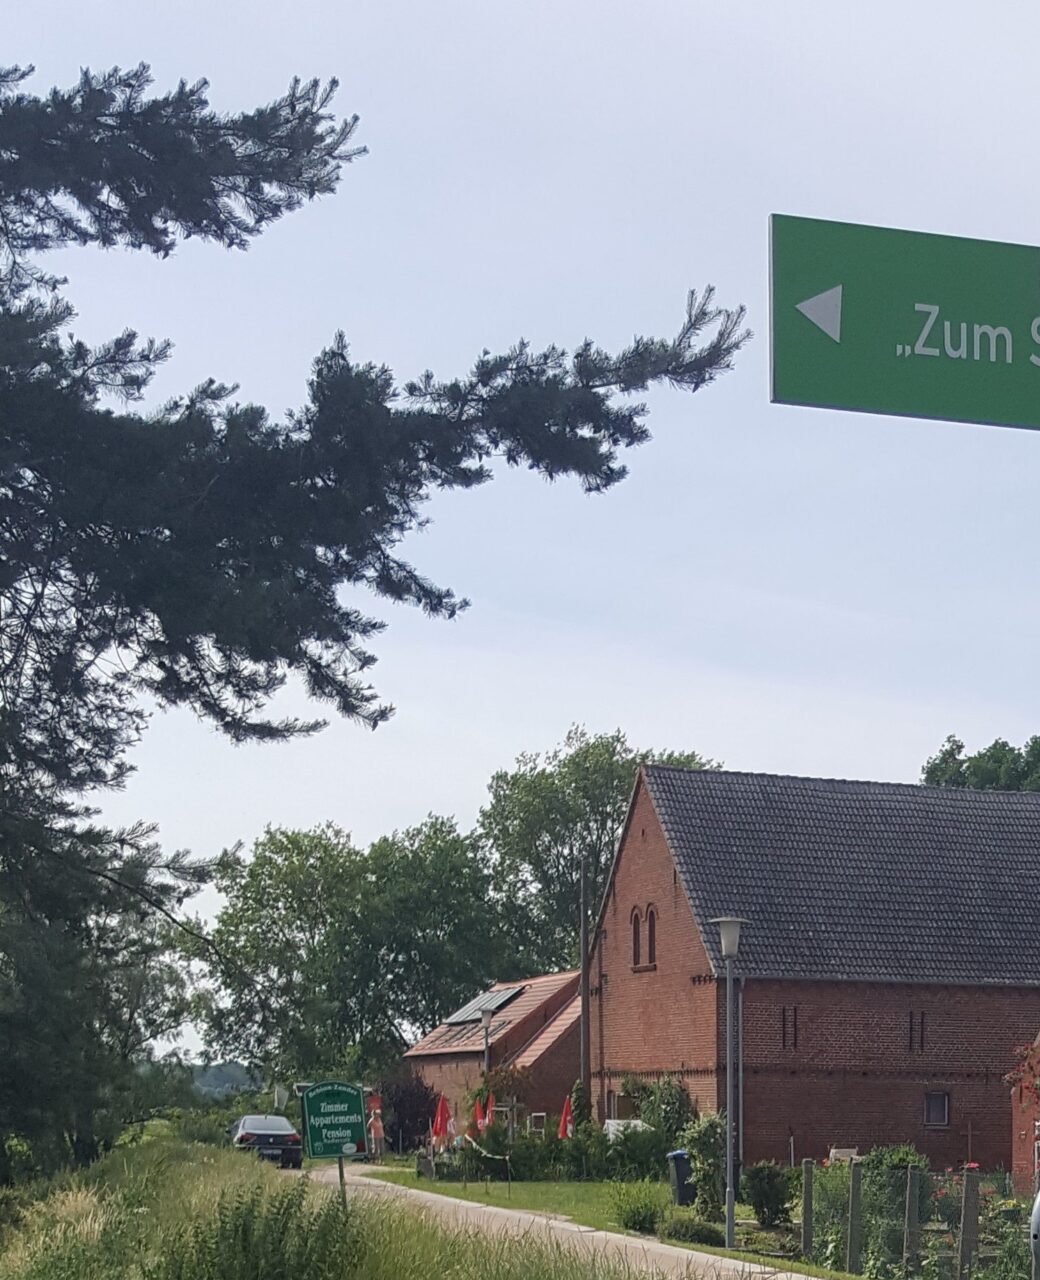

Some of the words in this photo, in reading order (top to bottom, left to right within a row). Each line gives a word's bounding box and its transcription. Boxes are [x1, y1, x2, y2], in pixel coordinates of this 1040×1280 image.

[320, 1102, 348, 1113] Zimmer
[310, 1113, 362, 1128] Appartements
[322, 1127, 351, 1139] Pension
